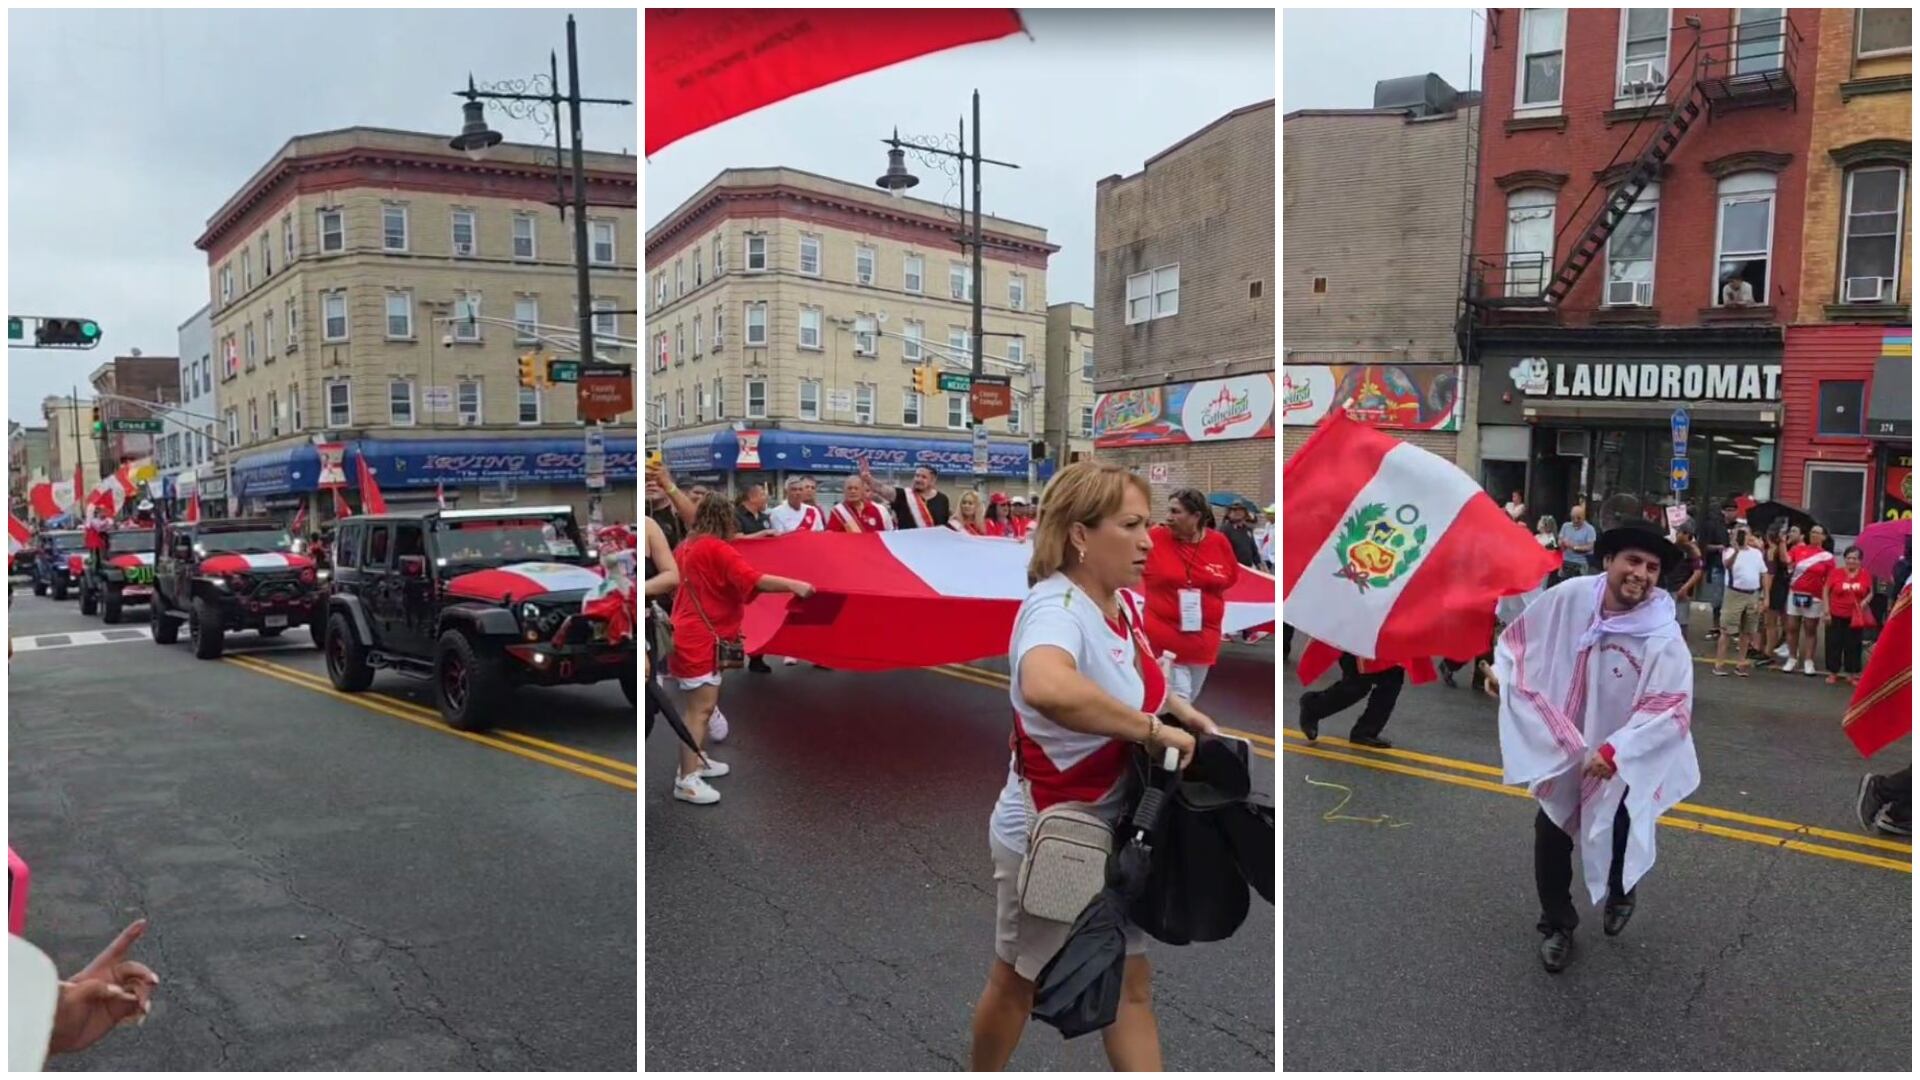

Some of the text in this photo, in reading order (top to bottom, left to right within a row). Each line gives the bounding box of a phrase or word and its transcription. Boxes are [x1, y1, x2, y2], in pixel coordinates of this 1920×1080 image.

[1555, 363, 1782, 399] LAUNDROMAT
[119, 420, 146, 430] Grand
[1880, 423, 1894, 433] 374
[422, 454, 526, 471] IRVING
[917, 450, 1026, 465] PHARACY
